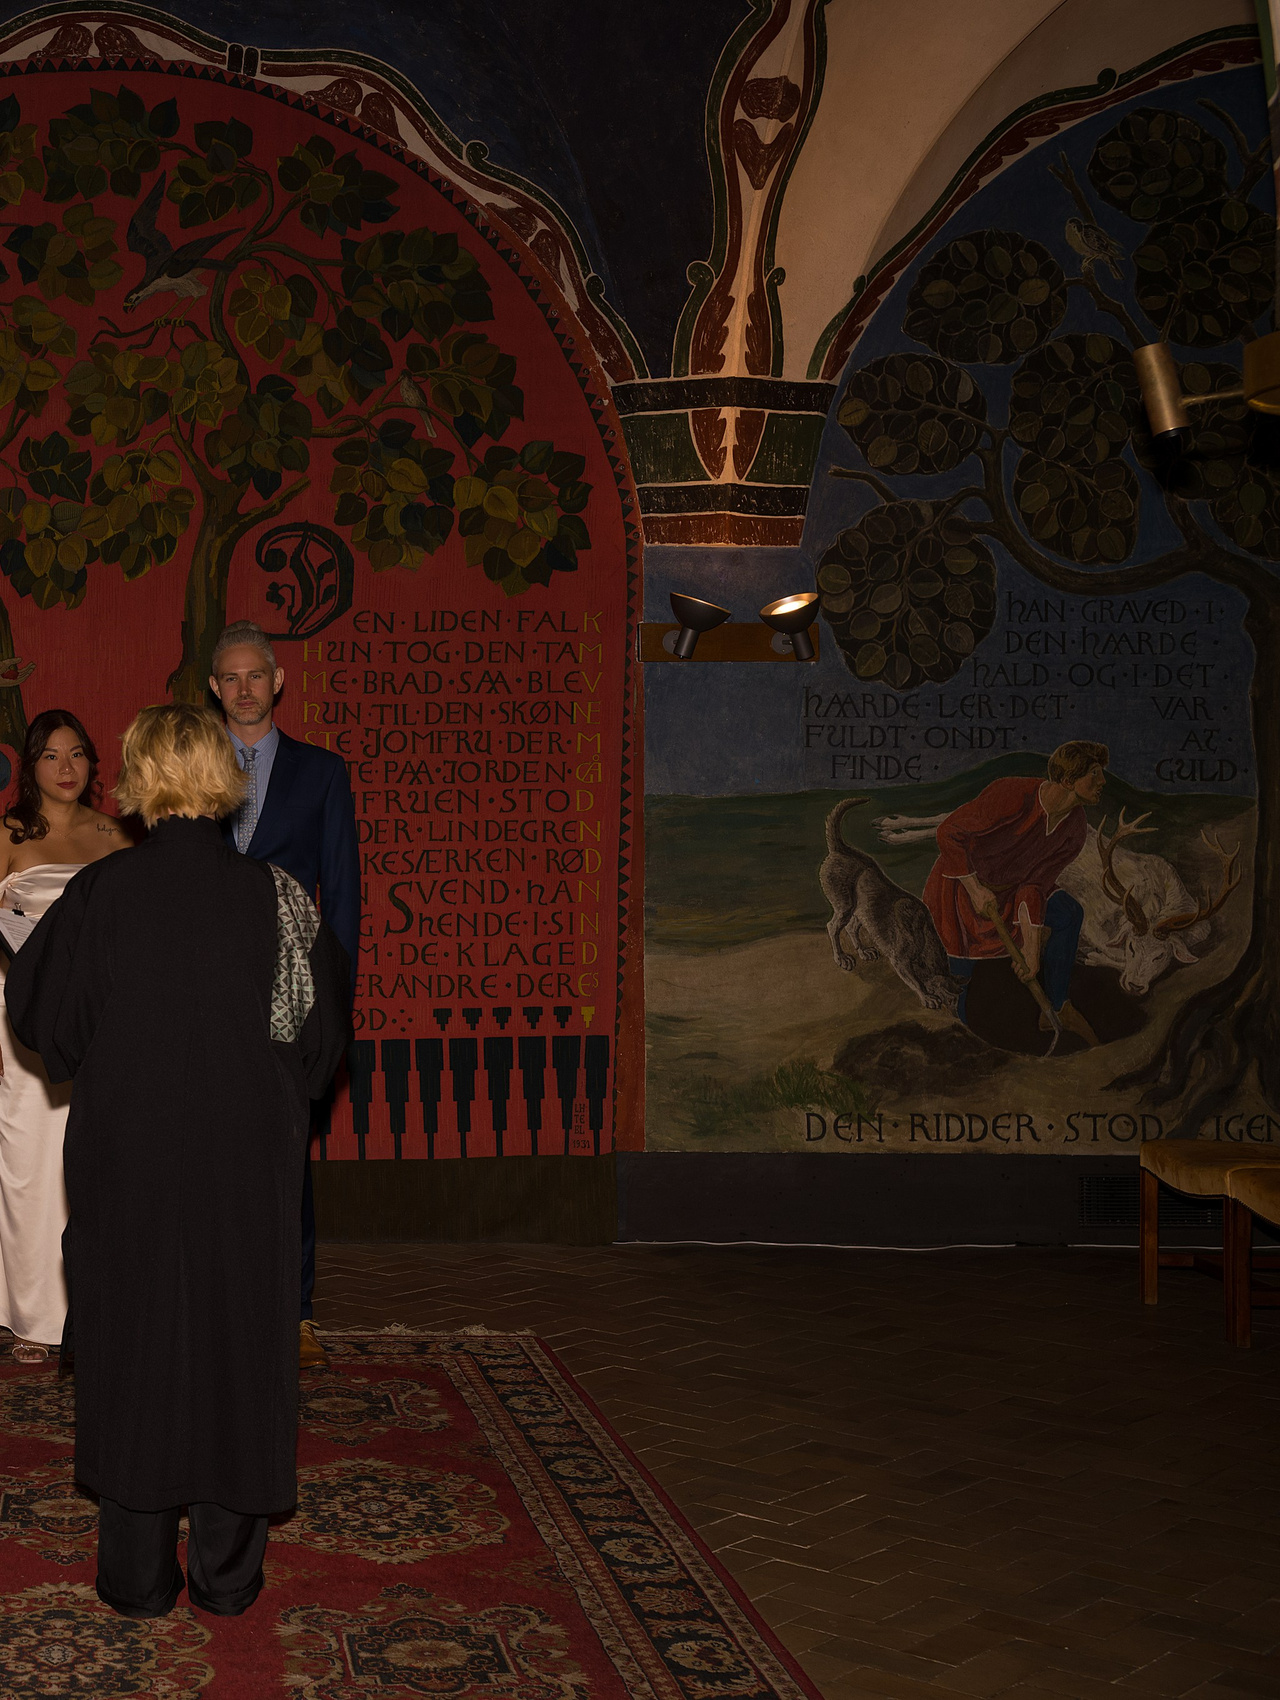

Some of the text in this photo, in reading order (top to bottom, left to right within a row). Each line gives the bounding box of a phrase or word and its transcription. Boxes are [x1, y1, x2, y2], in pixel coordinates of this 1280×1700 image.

[413, 610, 502, 633] LIDEN
[517, 610, 604, 634] FALK
[1081, 598, 1187, 626] GRAVED
[303, 640, 602, 664] HUN TOG DEN TAM
[1006, 630, 1067, 658] DEN
[302, 669, 603, 695] ME BRAD SAA BLEV
[1068, 663, 1116, 690] OG
[1153, 662, 1216, 690] DET
[370, 703, 417, 725] TIL
[424, 702, 483, 725] DEN
[937, 692, 998, 722] LER
[1009, 693, 1069, 722] DET
[1151, 696, 1214, 721] VAR
[362, 727, 493, 758] JOMFRU
[505, 731, 568, 754] DER
[804, 724, 908, 748] FULDT
[924, 726, 1016, 750] ONDT
[384, 760, 435, 785] PAA
[443, 759, 567, 784] JORDEN
[830, 753, 1238, 784] FINDE GULD
[352, 788, 594, 814] FRUEN STOD
[427, 820, 601, 844] LINDEGREN
[360, 848, 603, 874] KESÆRKEN RØD
[548, 910, 599, 936] SIN
[399, 941, 439, 967] DE
[805, 1112, 885, 1143] DEN
[908, 1112, 1042, 1145] RIDDER
[1062, 1112, 1164, 1143] STOD
